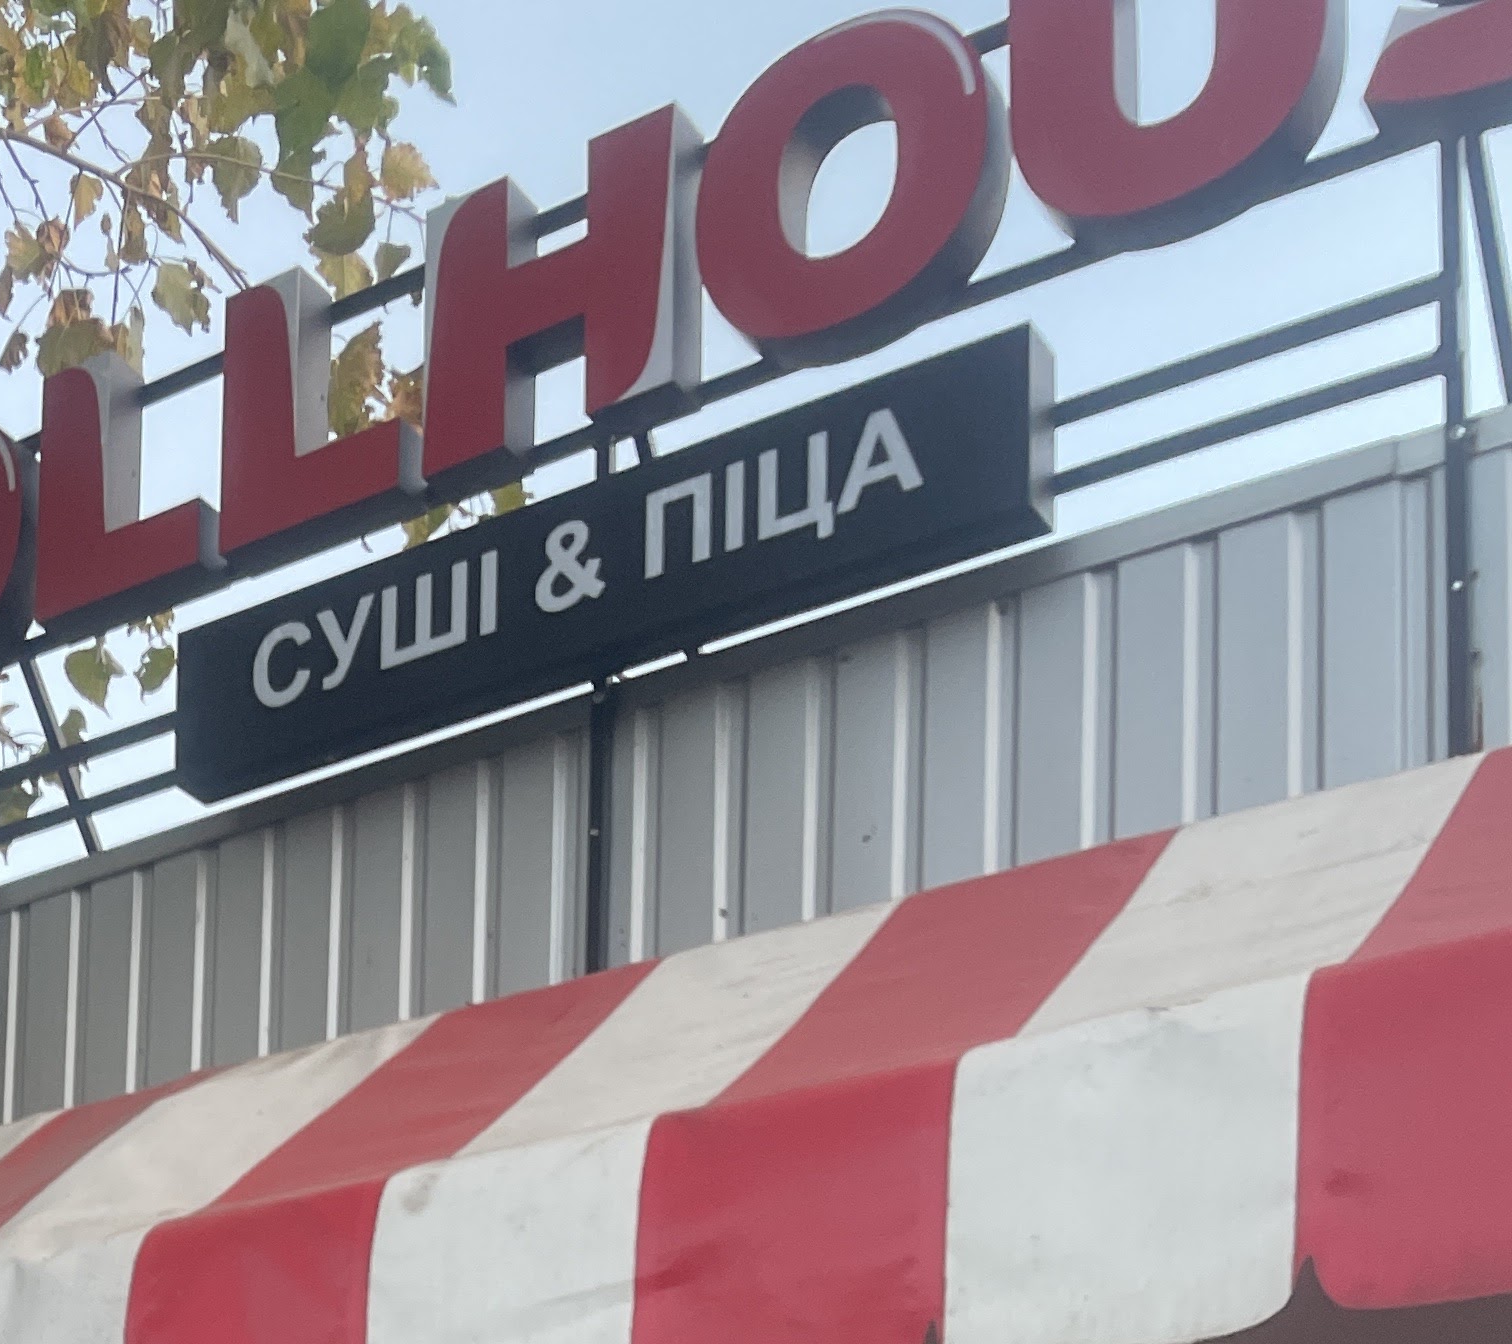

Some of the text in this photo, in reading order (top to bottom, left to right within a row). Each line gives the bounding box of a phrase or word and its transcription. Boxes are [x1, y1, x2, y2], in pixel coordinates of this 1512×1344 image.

[251, 407, 924, 708] СУШІ & ПІЦА
